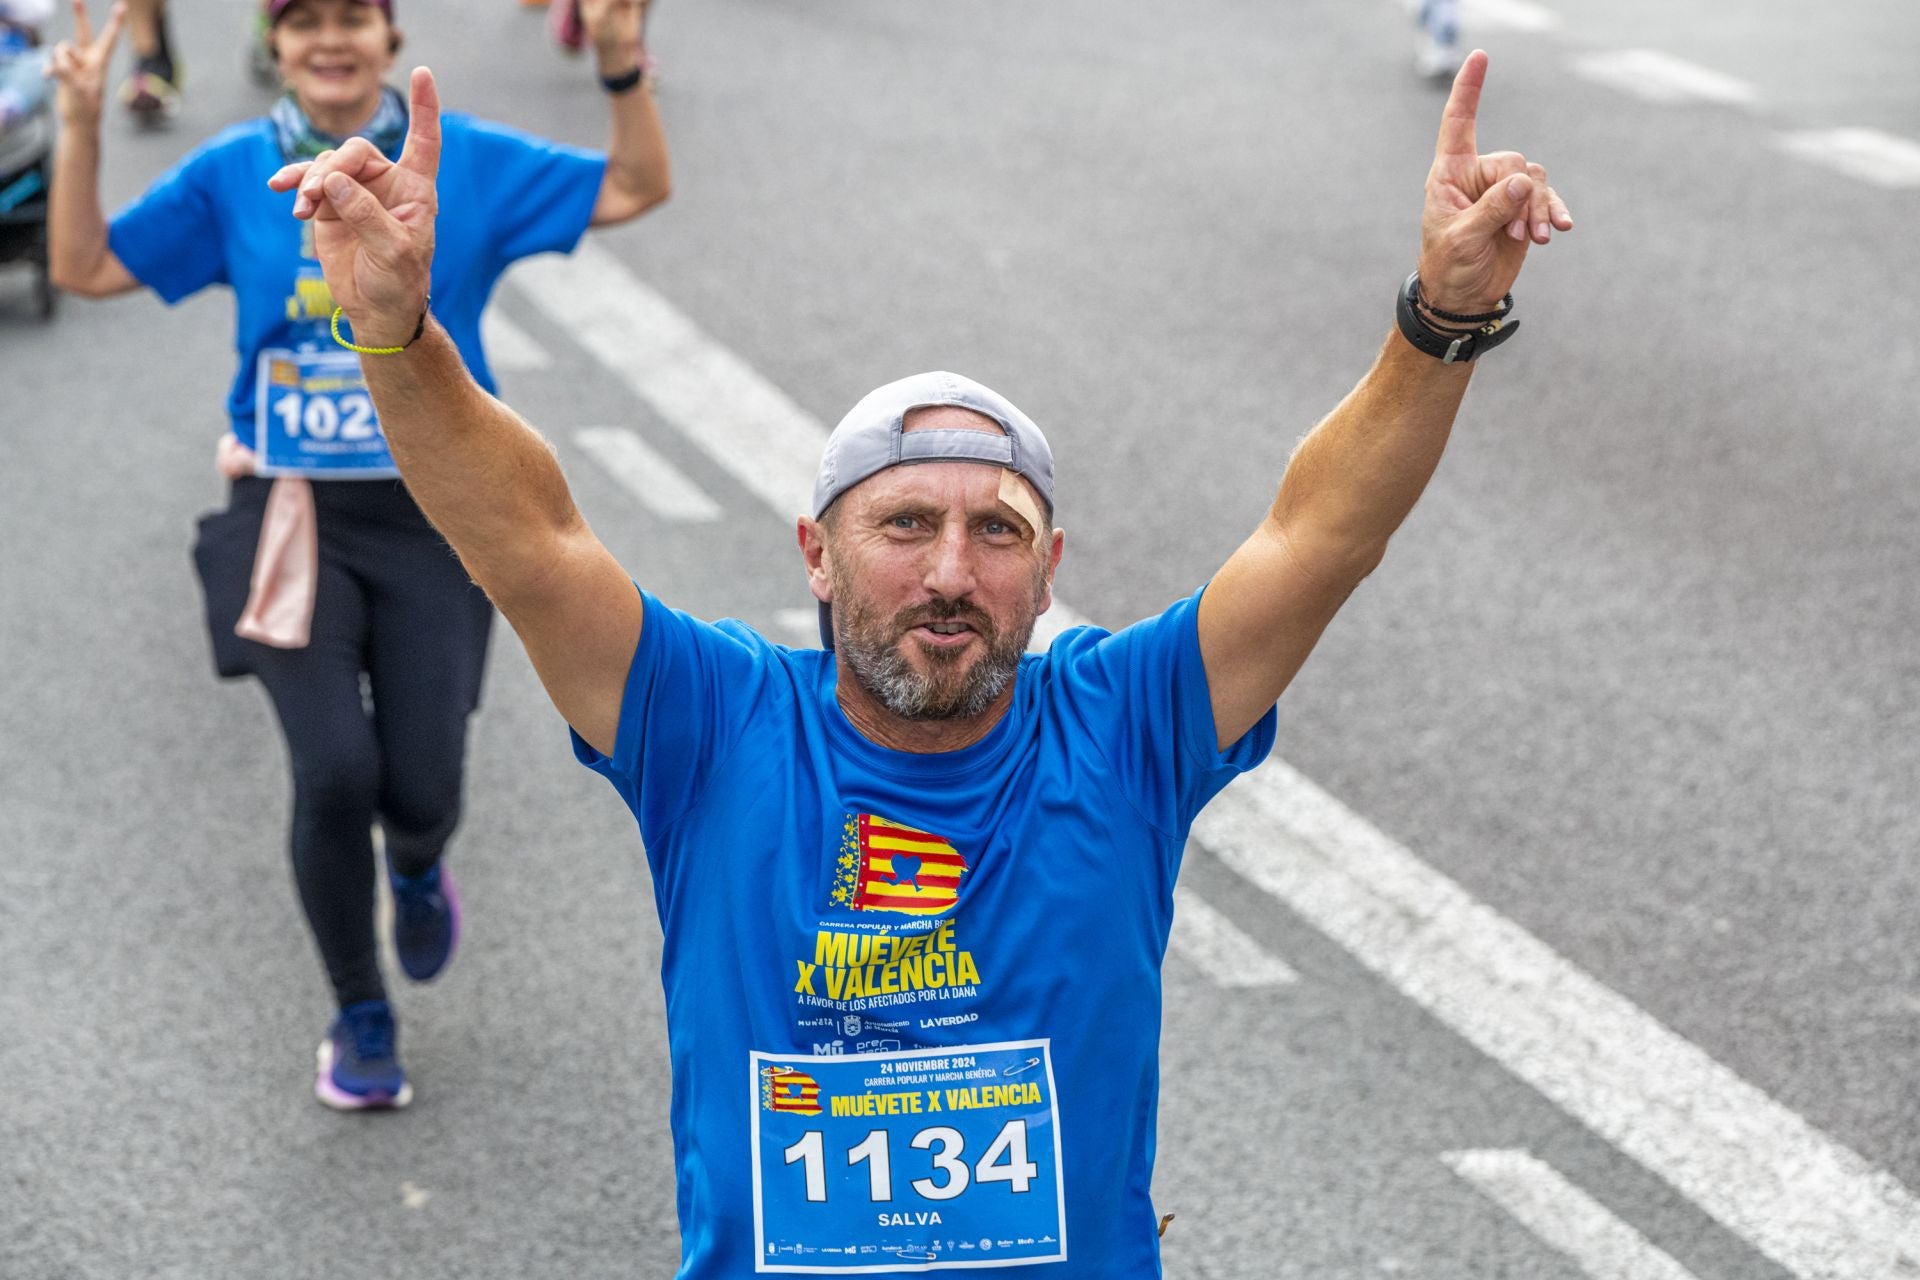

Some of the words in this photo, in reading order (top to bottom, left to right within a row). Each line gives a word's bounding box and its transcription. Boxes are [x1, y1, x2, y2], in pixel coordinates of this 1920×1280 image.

[273, 392, 383, 442] 102
[819, 921, 855, 929] CARRERA
[900, 920, 933, 930] MARCHA
[815, 918, 957, 968] MUÉVETE
[794, 960, 816, 995] X
[824, 951, 981, 1001] VALENCIA
[798, 995, 804, 1005] A
[806, 996, 834, 1009] FAVOR
[836, 1001, 847, 1011] DE
[850, 998, 866, 1012] LOS
[868, 991, 916, 1009] AFECTADOS
[918, 988, 936, 1002] POR
[938, 988, 950, 1000] LA
[952, 985, 977, 998] DANA
[865, 1076, 896, 1087] CARRERA
[897, 1074, 928, 1085] POPULAR
[929, 1074, 934, 1083] Y
[935, 1071, 964, 1082] MARCHA
[965, 1067, 997, 1080] BENÉFICA
[881, 1063, 893, 1074] 24
[896, 1058, 949, 1073] NOVIEMBRE
[952, 1056, 976, 1069] 2024
[831, 1091, 923, 1117] MUÉVETE
[926, 1091, 943, 1113] X
[945, 1082, 1041, 1111] VALENCIA
[783, 1119, 1039, 1202] 1134
[878, 1211, 942, 1227] SALVA
